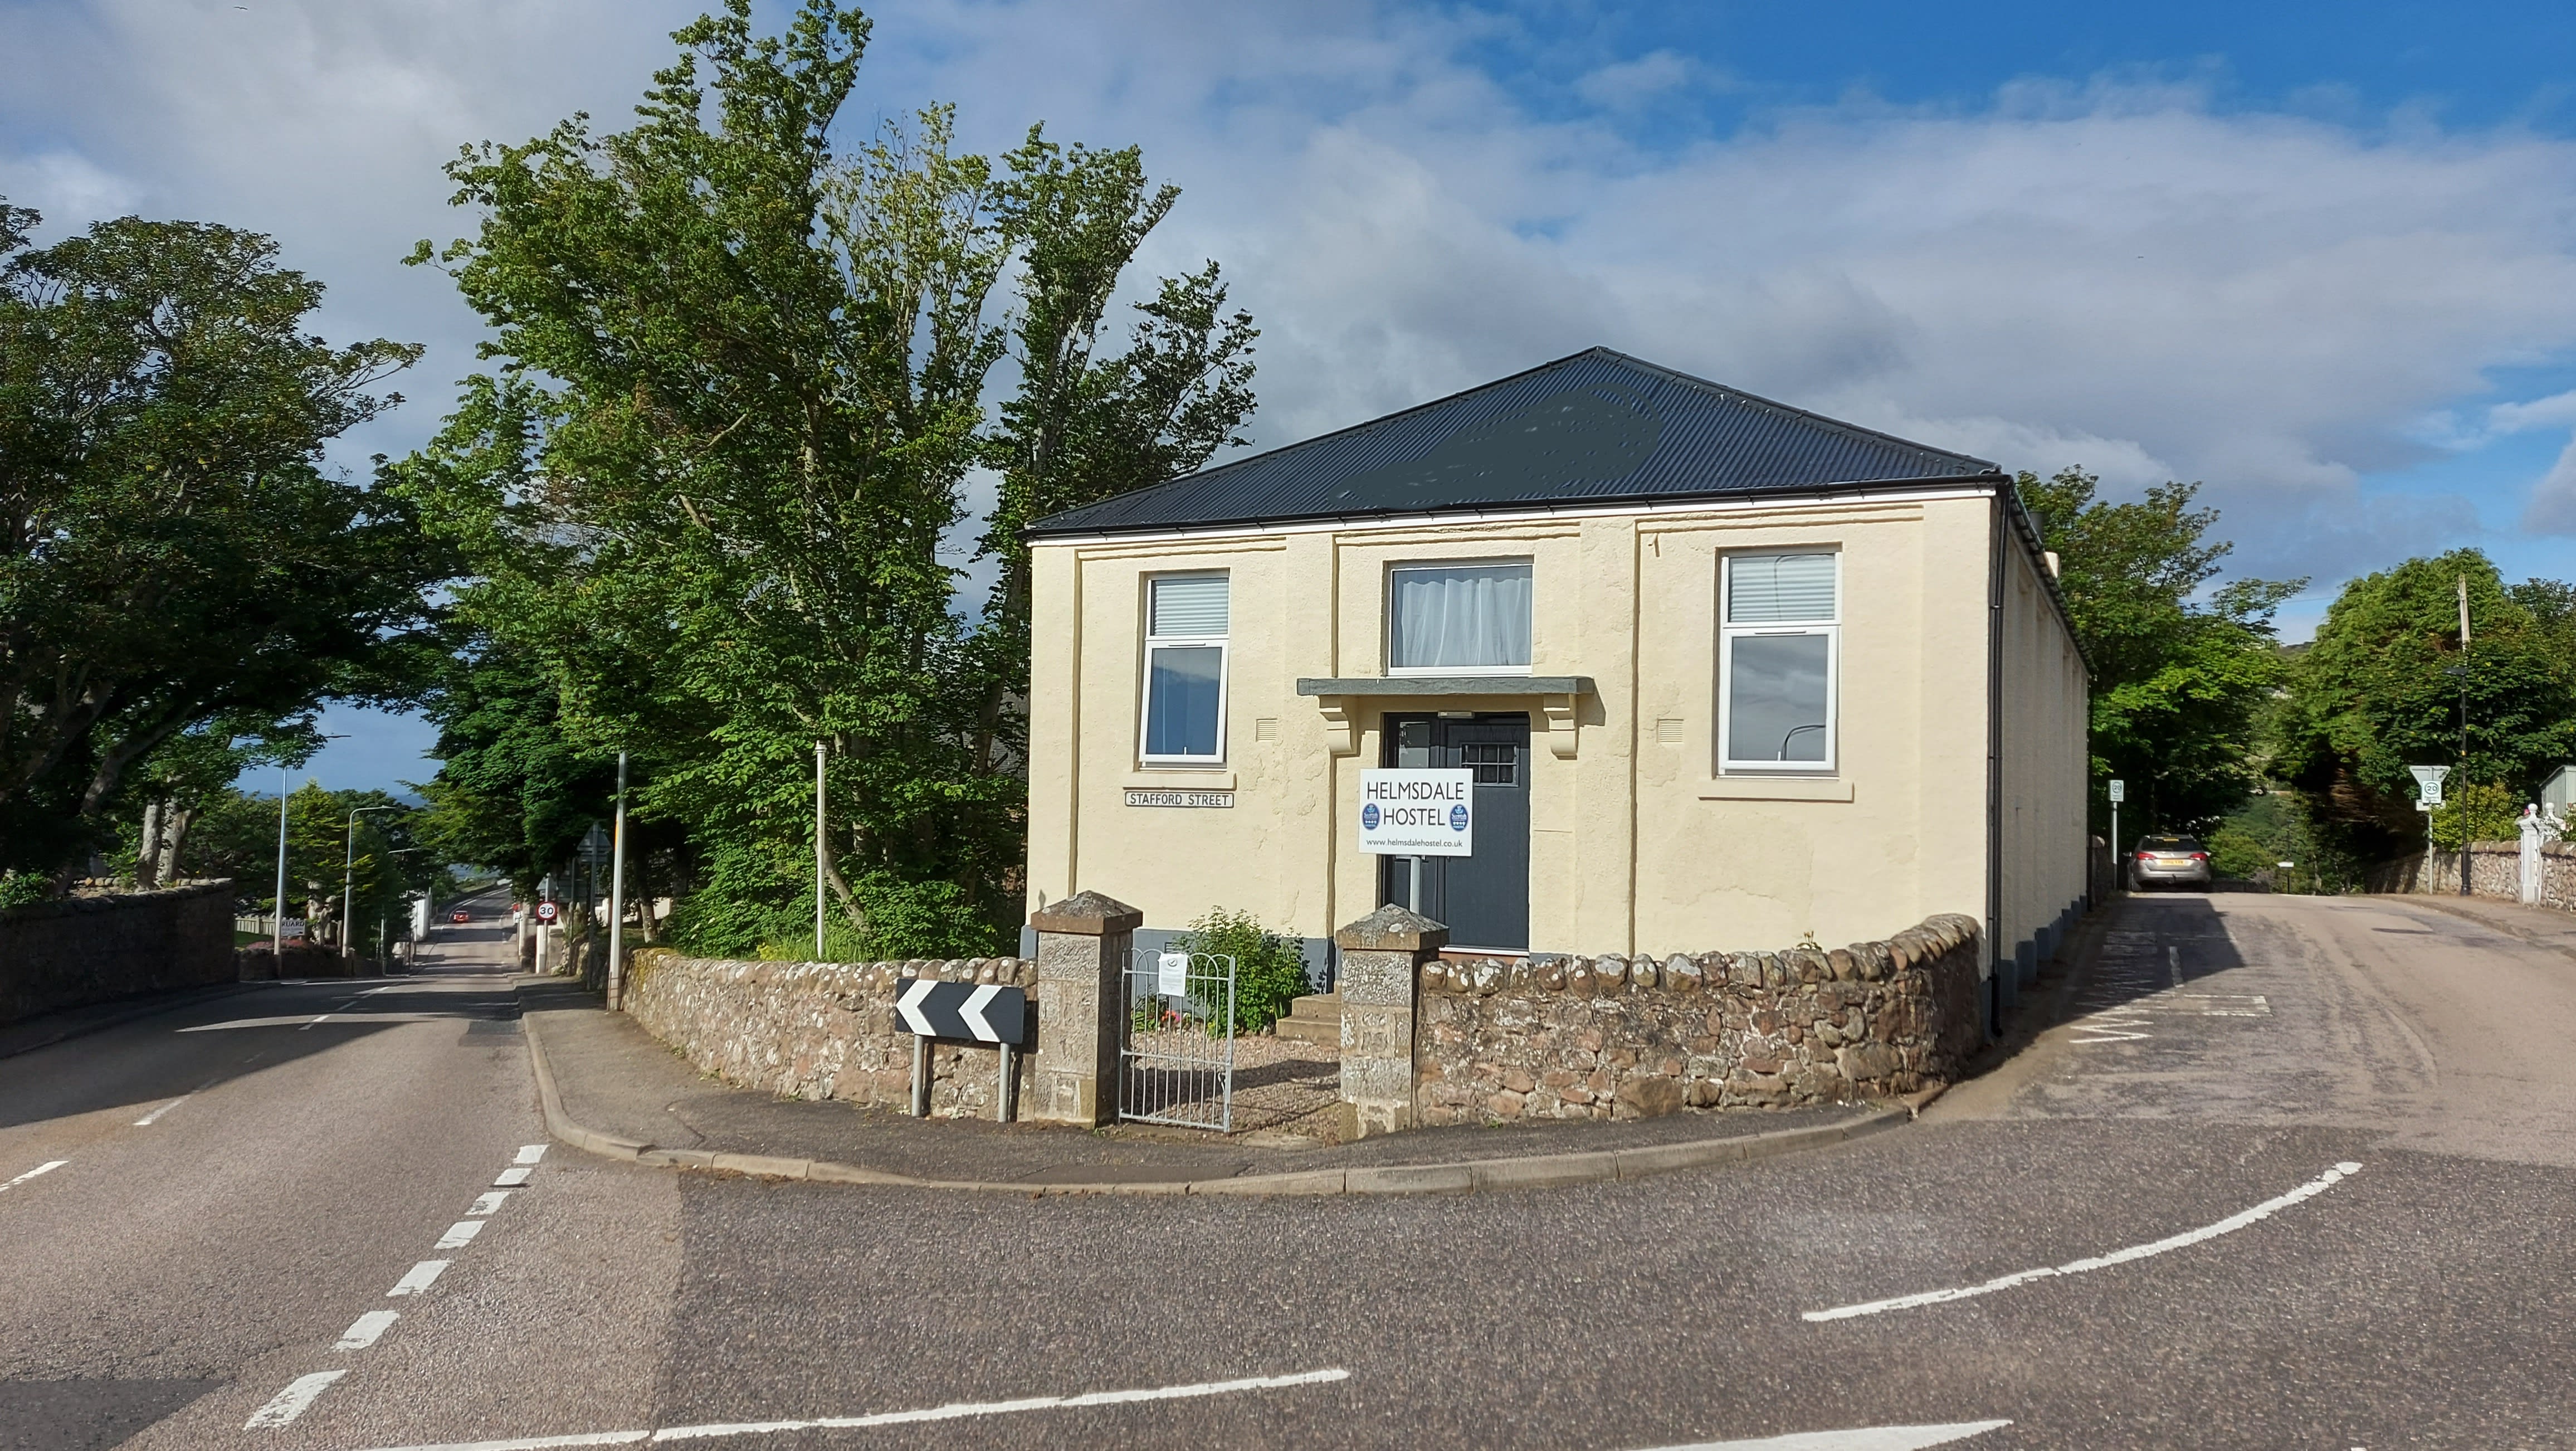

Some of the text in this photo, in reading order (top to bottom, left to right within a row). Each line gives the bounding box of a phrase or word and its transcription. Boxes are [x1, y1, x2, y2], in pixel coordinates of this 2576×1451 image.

[1367, 782, 1464, 800] HELMSDALE
[1130, 793, 1229, 806] STAFFORD STREET
[1383, 808, 1446, 826] HOSTEL
[1366, 838, 1463, 848] www.helmsdalehostel.co.uk
[539, 907, 554, 915] 30
